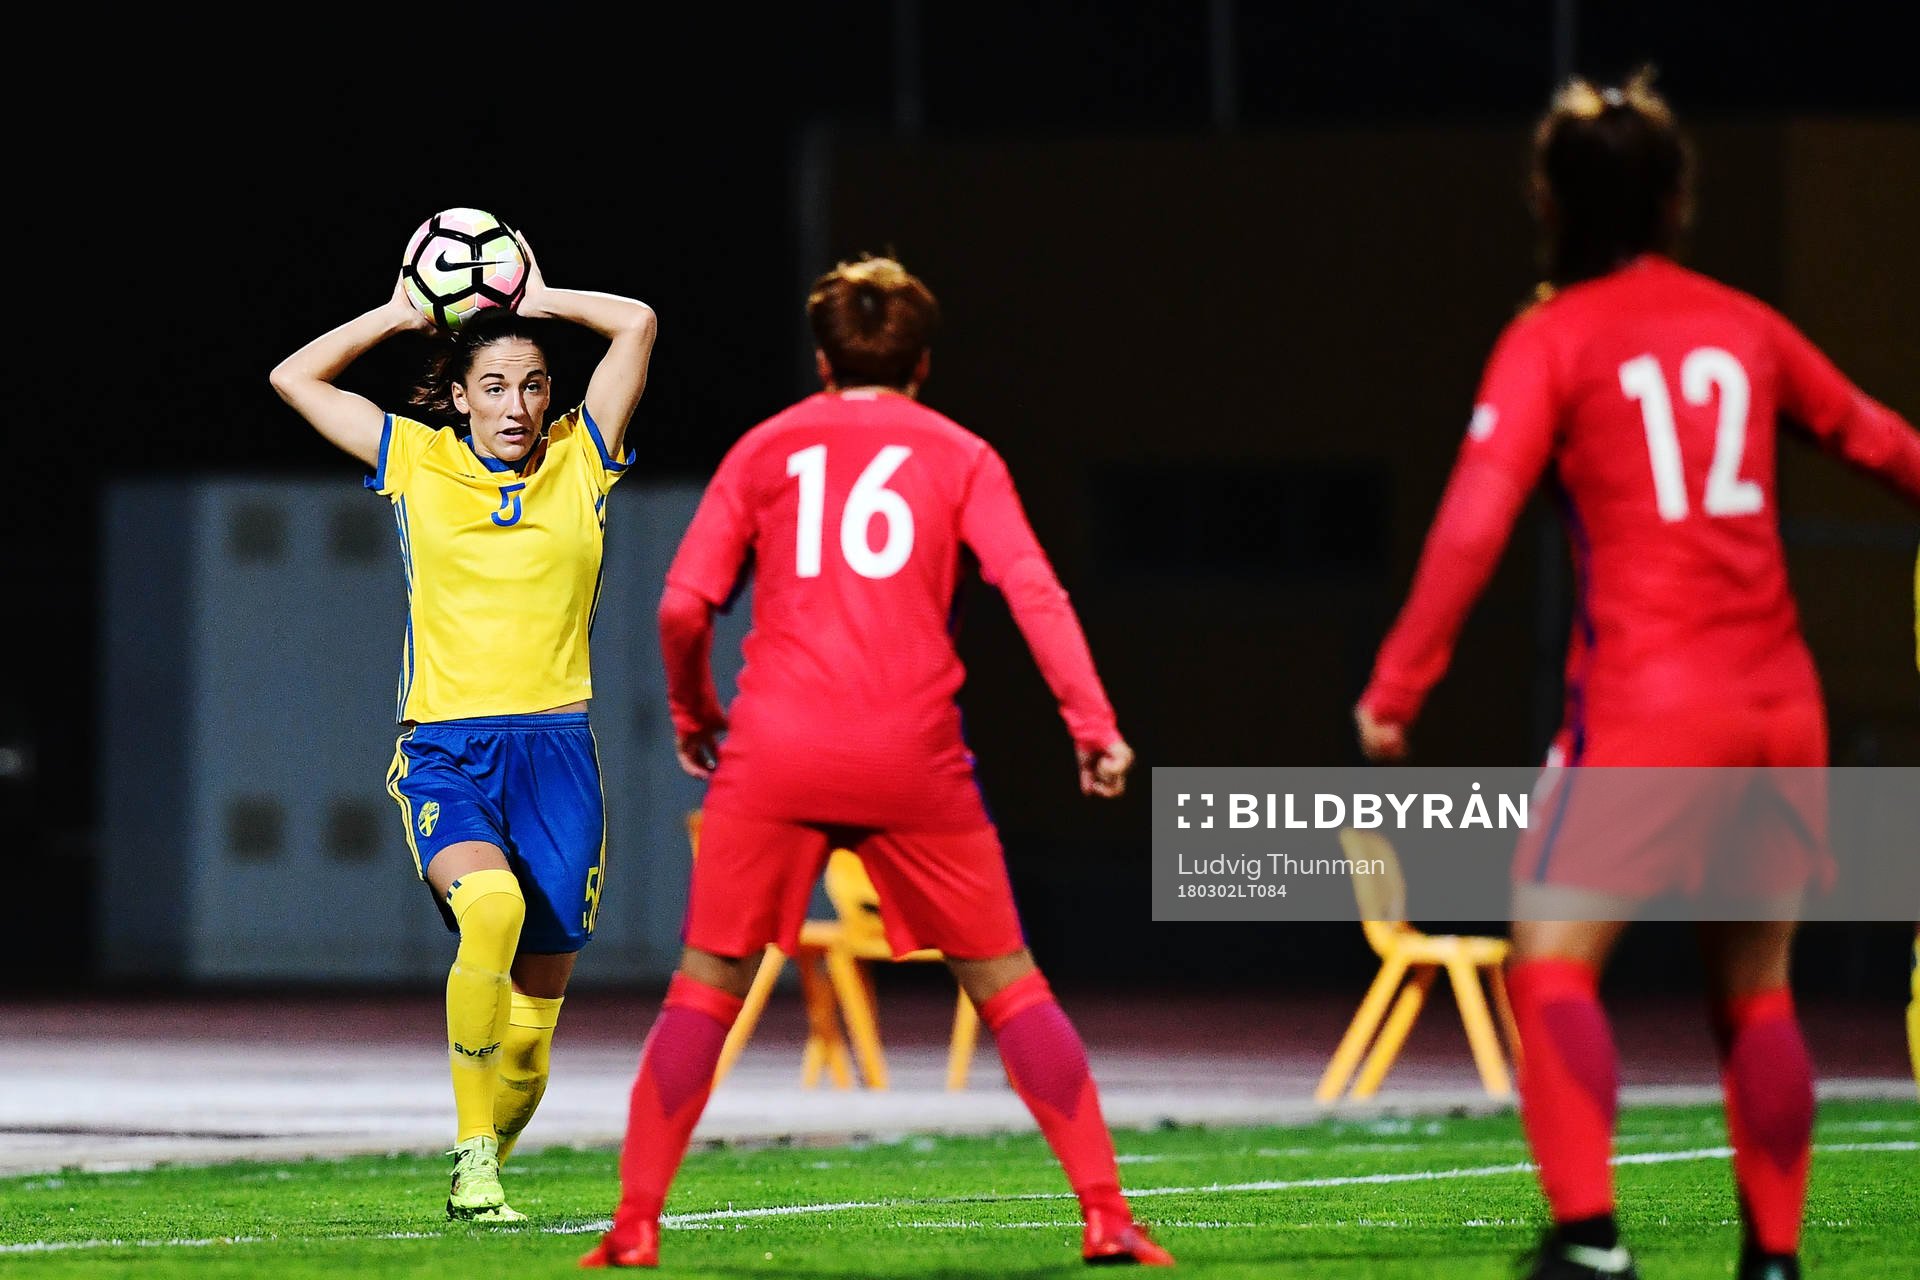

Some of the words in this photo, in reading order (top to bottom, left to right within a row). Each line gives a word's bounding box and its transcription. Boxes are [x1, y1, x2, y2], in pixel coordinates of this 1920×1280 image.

[1618, 346, 1765, 523] 12
[491, 482, 526, 527] 5
[786, 443, 915, 580] 16
